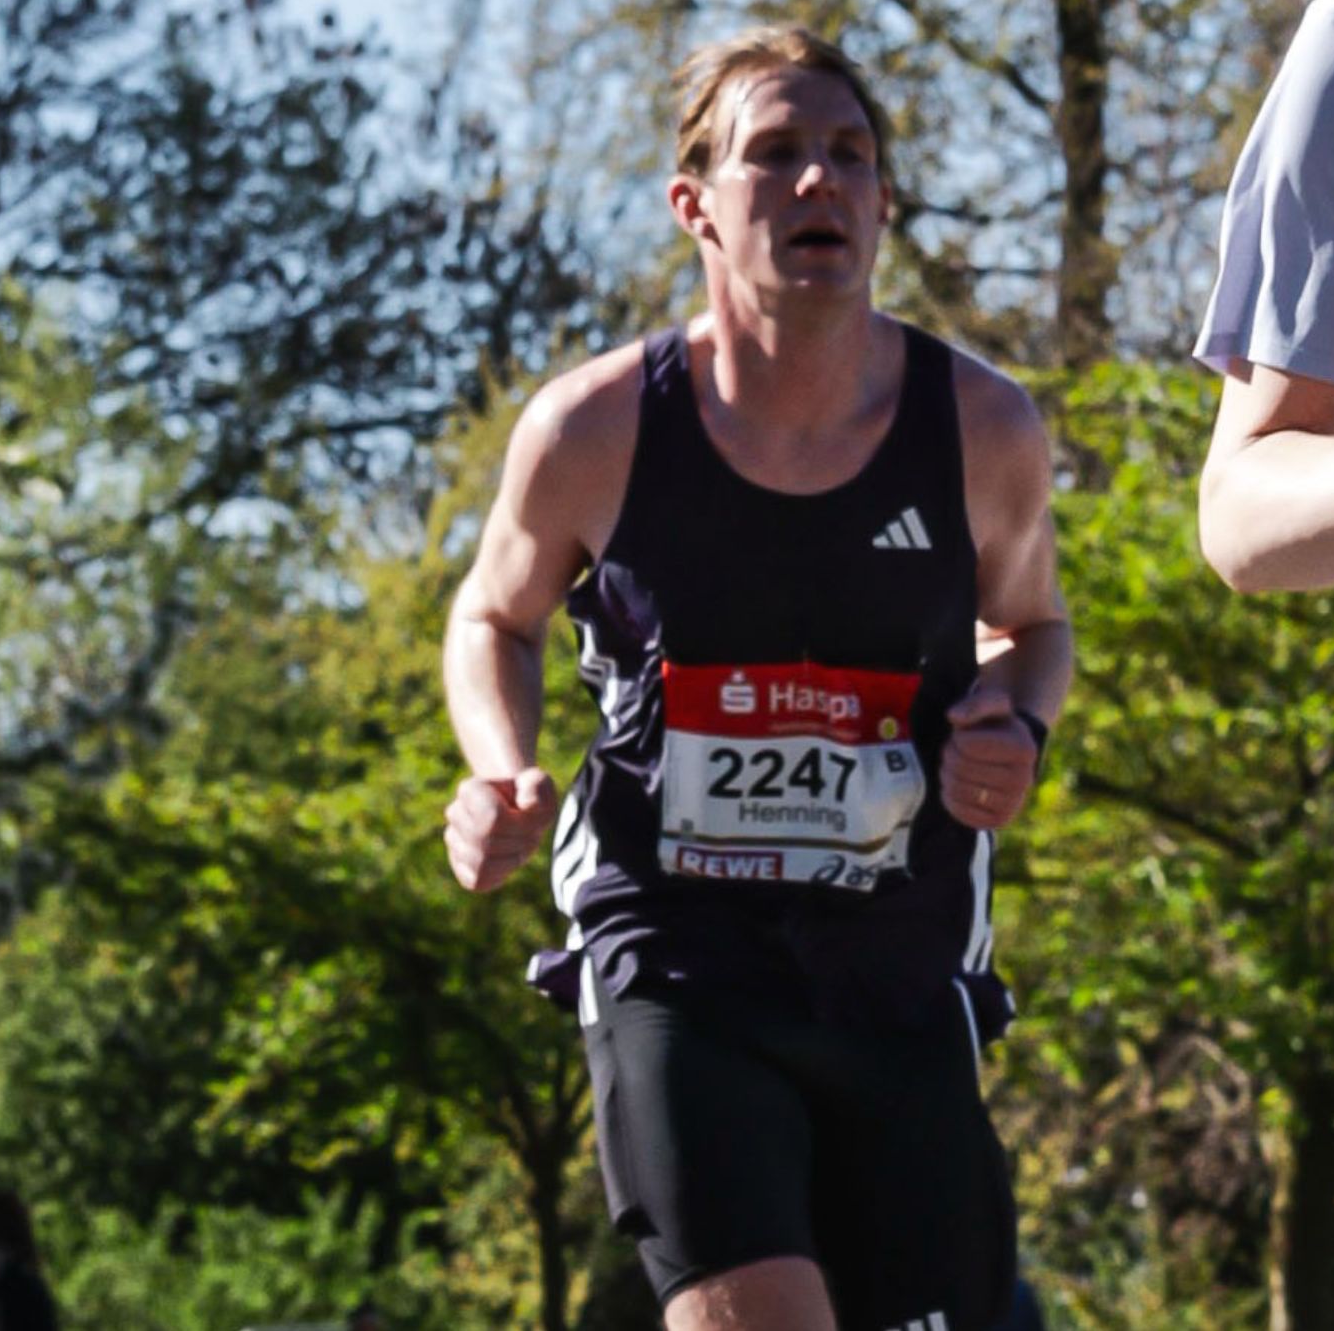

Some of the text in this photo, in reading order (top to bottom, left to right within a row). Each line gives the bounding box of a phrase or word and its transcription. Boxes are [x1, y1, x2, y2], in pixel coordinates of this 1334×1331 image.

[707, 746, 857, 803] 2247
[738, 802, 848, 833] Henning
[680, 850, 777, 879] REWE
